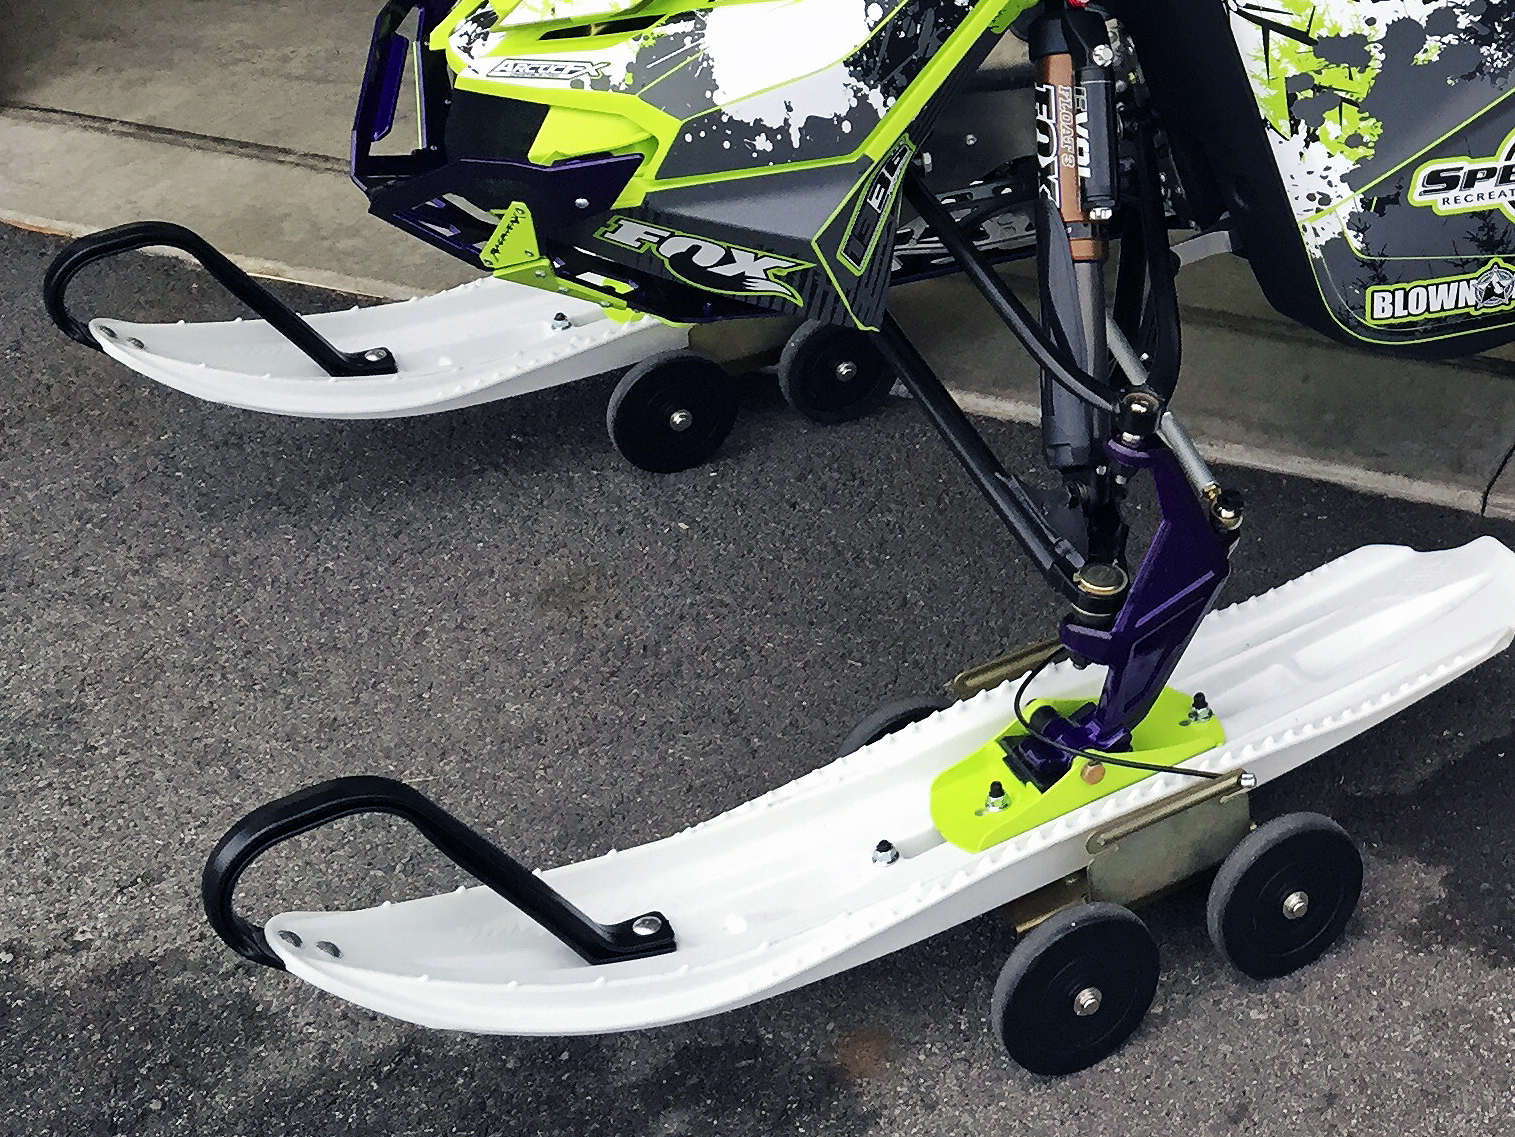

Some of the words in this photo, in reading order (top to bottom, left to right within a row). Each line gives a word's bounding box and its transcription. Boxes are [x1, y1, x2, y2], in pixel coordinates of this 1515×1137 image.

[493, 58, 611, 80] ARCTICFX
[605, 217, 797, 294] FOX
[1373, 279, 1478, 320] BLOWN
